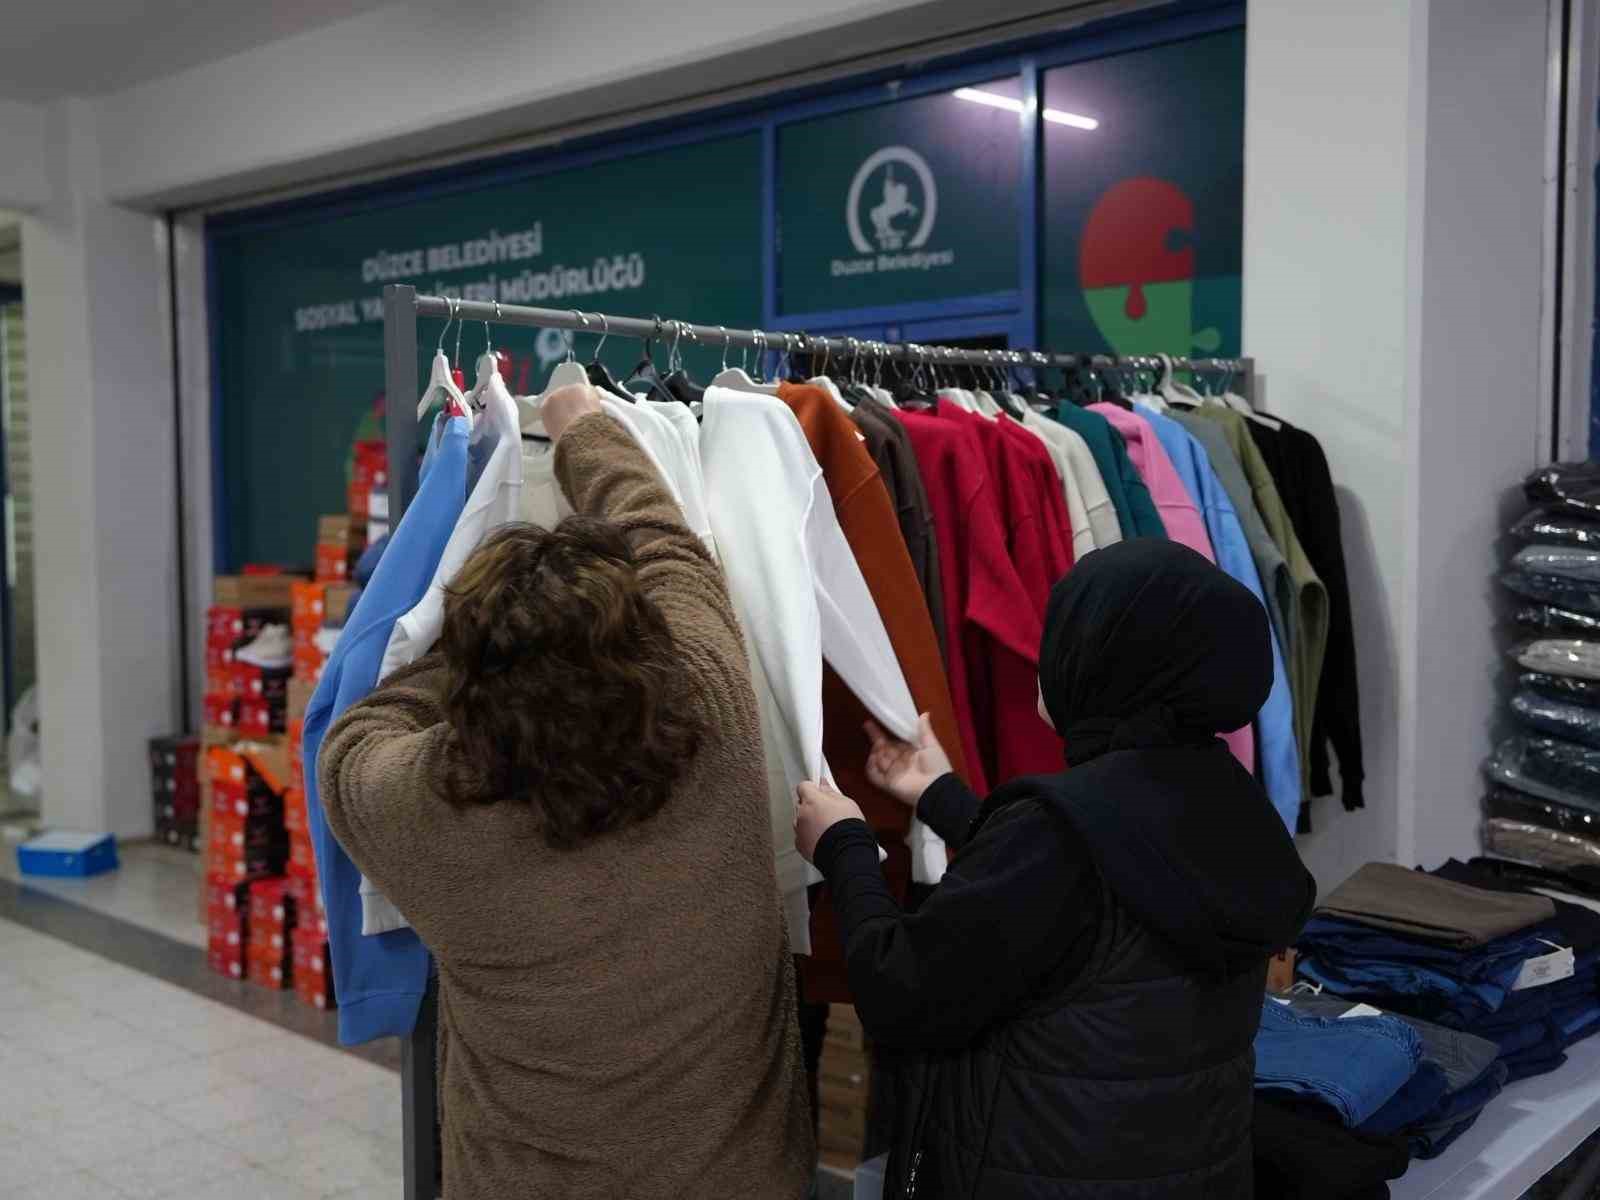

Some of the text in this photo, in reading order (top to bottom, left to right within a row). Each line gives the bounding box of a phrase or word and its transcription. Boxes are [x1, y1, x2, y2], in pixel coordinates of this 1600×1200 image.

[362, 221, 542, 283] DÜZCE BELEDİYESİ
[501, 253, 645, 303] MÜDÜRLÜĞÜ
